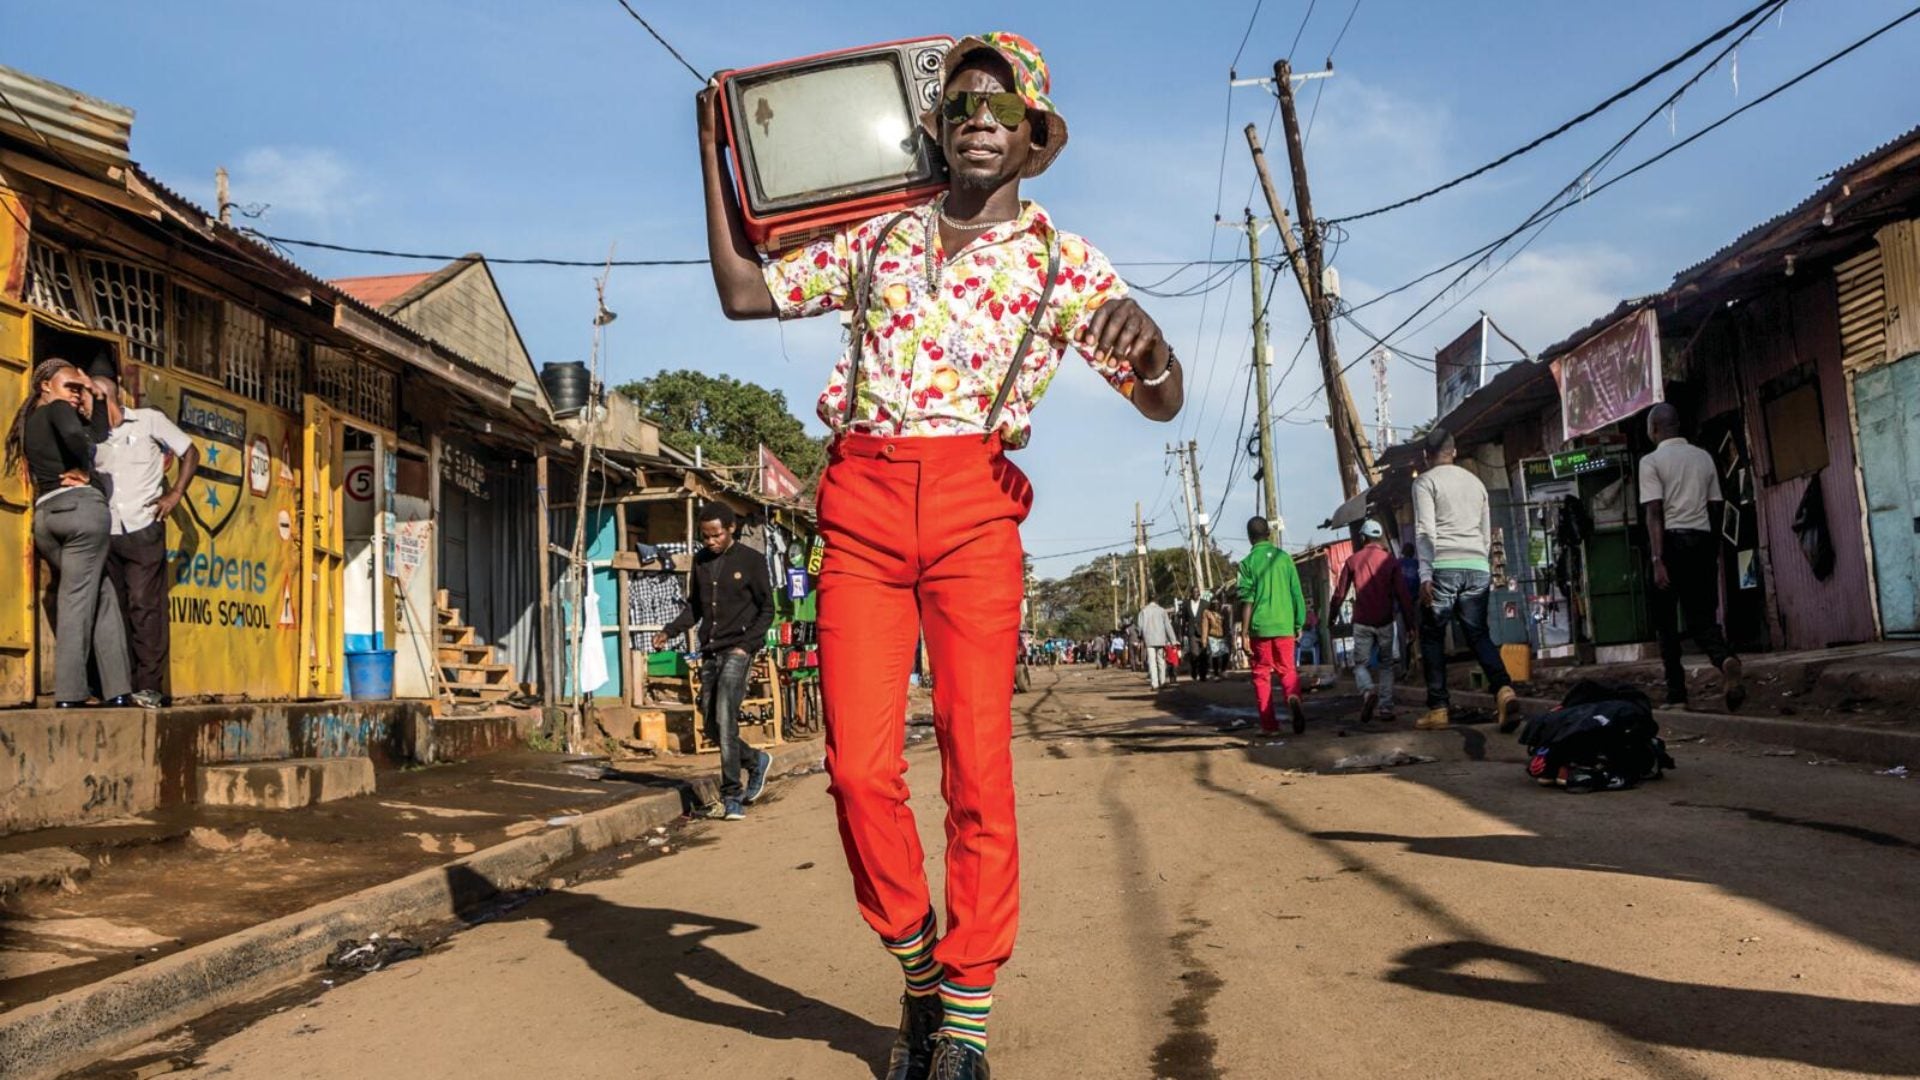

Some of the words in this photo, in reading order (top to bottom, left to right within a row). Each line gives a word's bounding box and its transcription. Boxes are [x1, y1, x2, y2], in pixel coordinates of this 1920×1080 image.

[251, 455, 270, 476] STOP
[170, 597, 212, 626] IVING
[218, 601, 271, 629] SCHOOL
